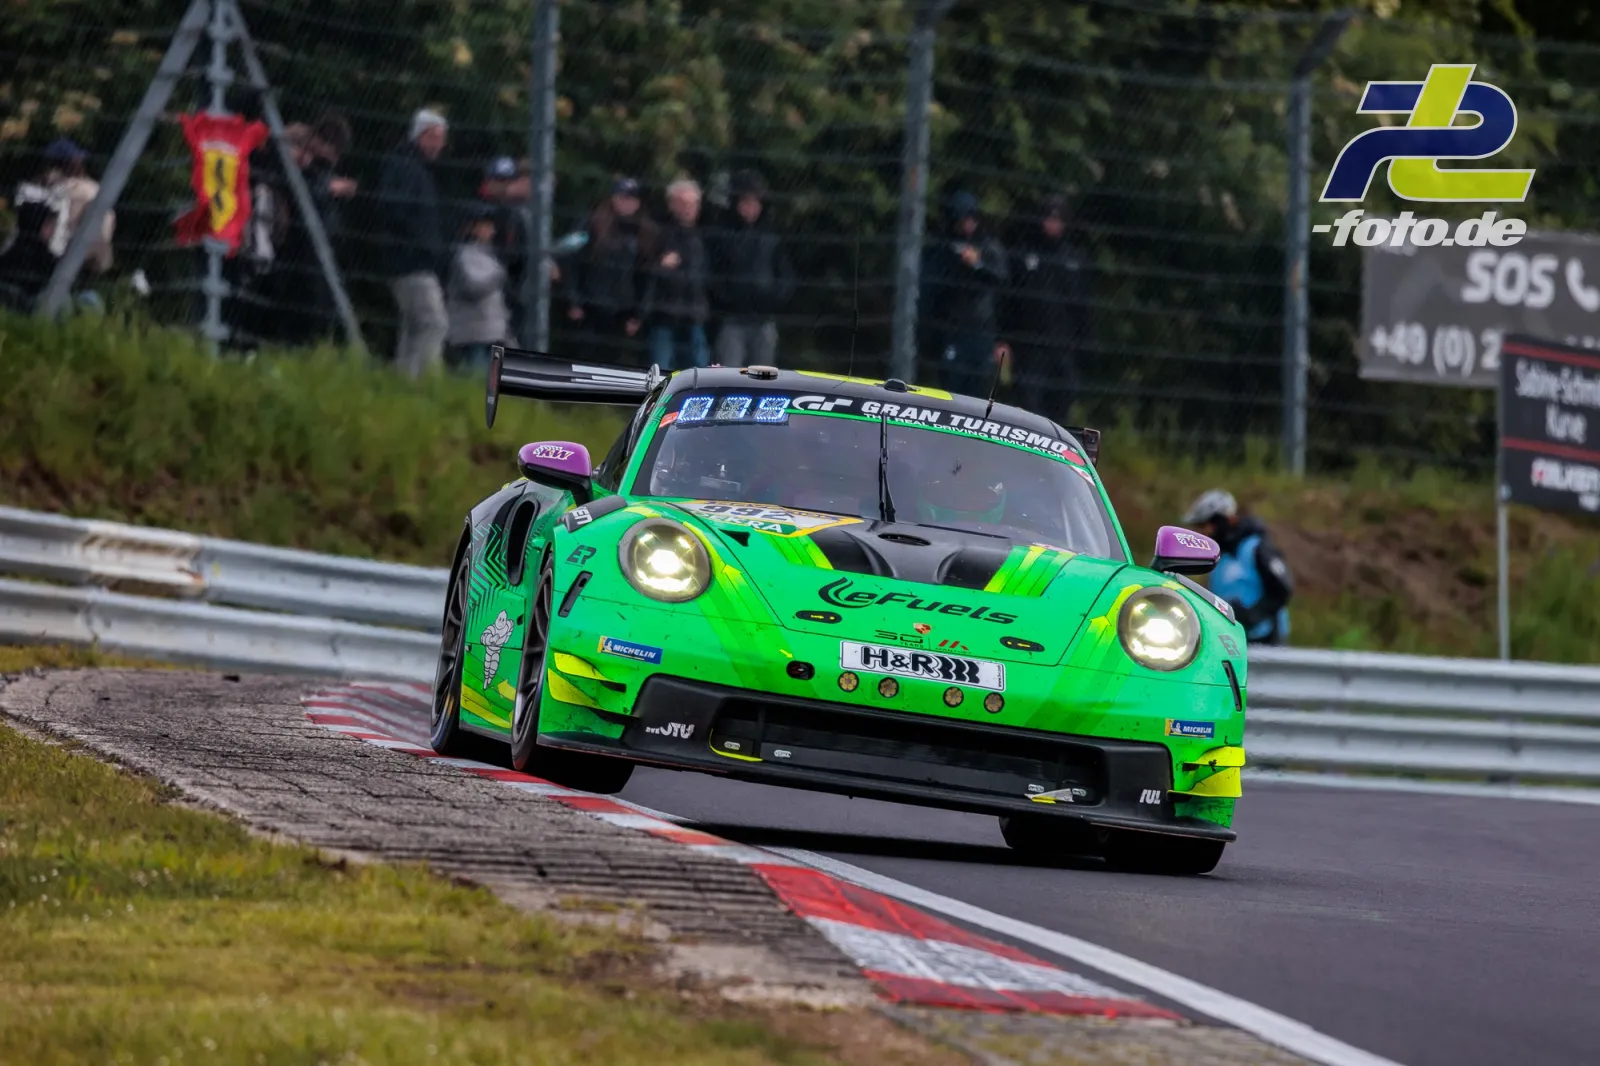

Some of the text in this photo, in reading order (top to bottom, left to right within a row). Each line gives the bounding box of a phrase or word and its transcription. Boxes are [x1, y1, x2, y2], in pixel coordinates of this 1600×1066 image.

[1461, 250, 1558, 308] SOS
[861, 401, 1068, 454] GRAN TURISMO
[843, 590, 1018, 625] eFuels
[613, 643, 656, 659] MICHELIN
[861, 646, 936, 676] H&R
[1182, 725, 1212, 735] MICHELIN
